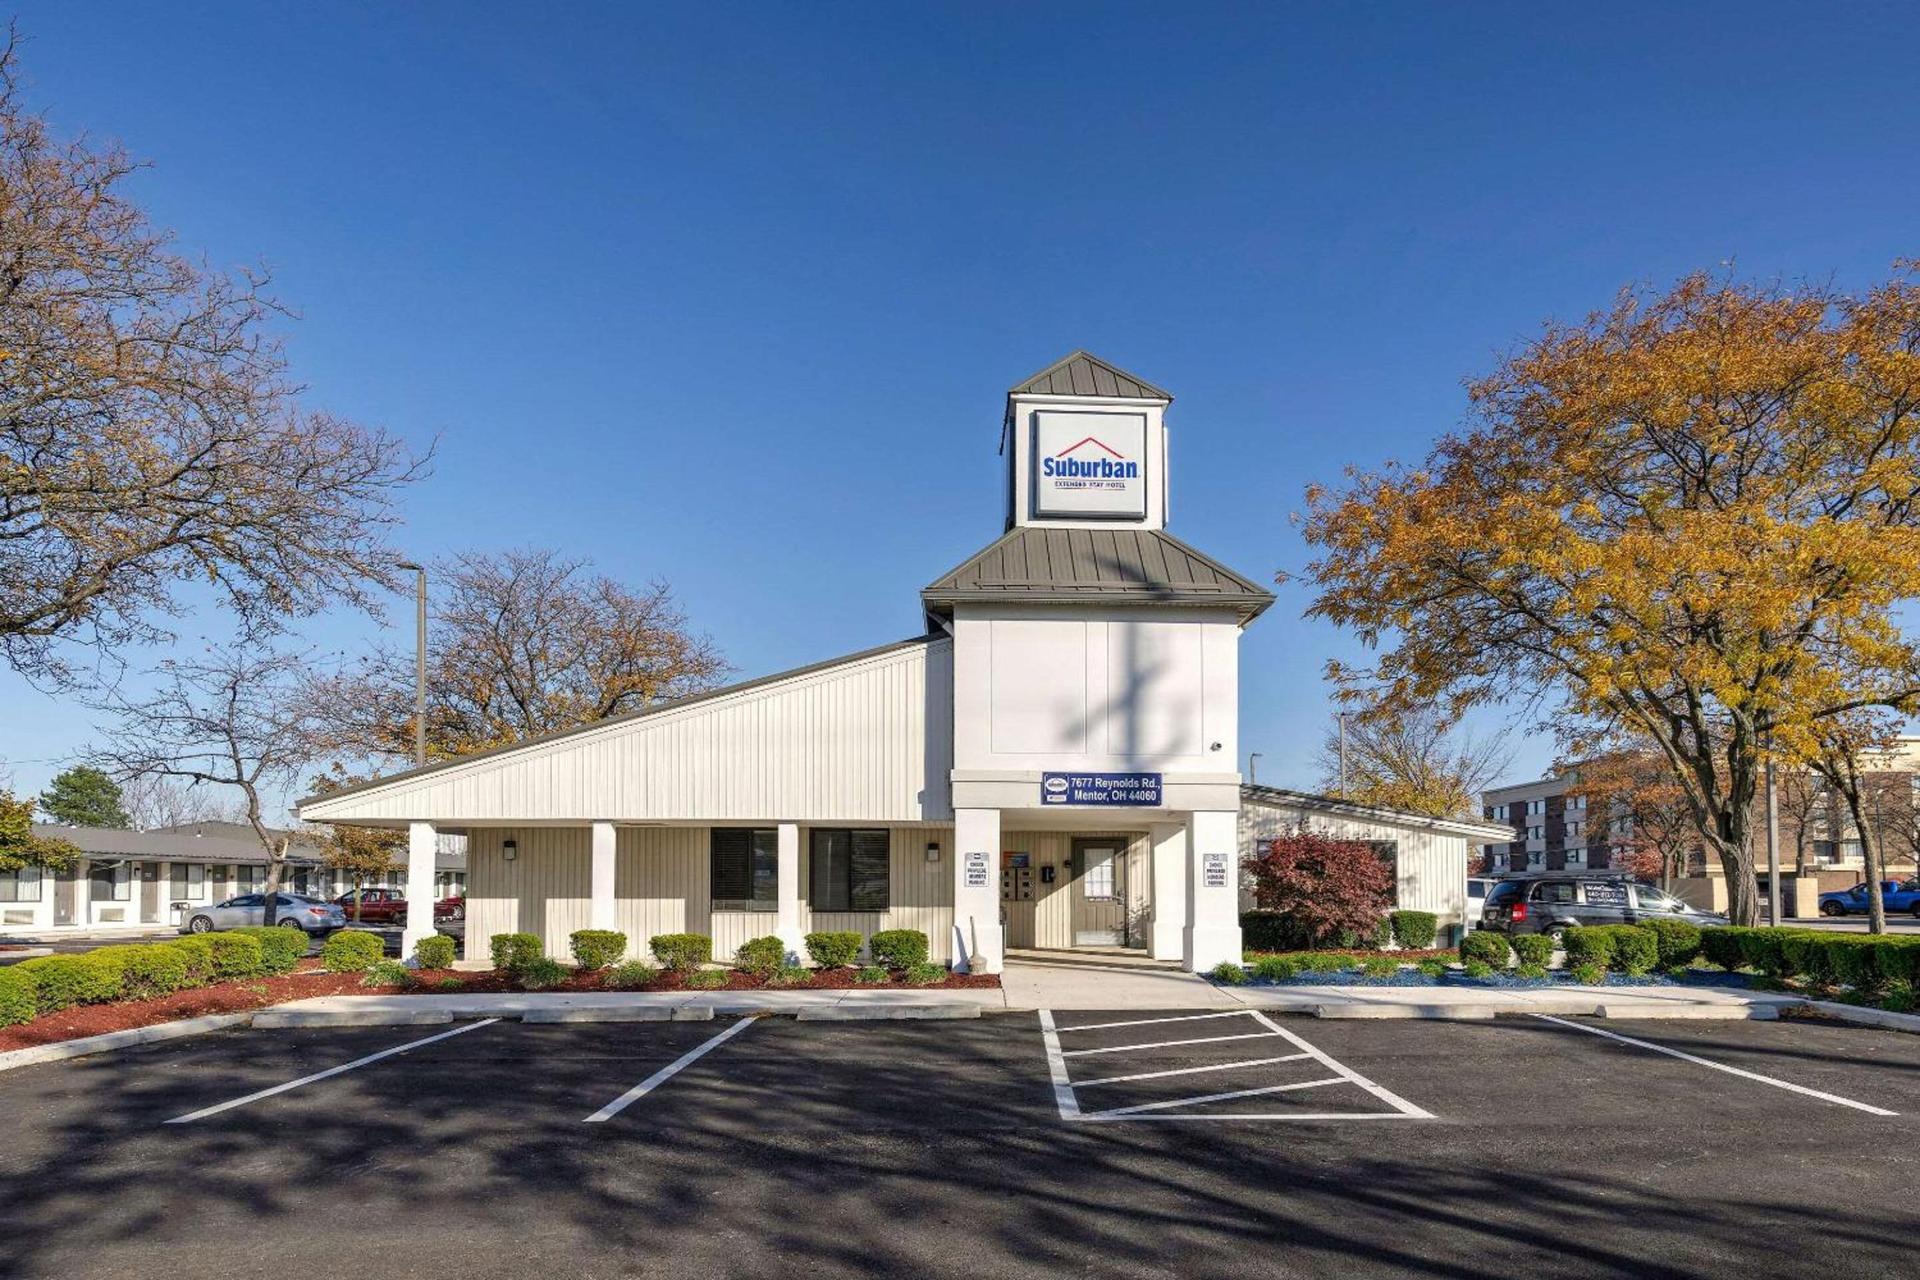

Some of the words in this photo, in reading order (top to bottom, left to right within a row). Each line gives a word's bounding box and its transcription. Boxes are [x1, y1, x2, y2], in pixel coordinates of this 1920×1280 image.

[1043, 457, 1138, 478] Suburban
[1071, 777, 1093, 788] 7677
[1095, 778, 1139, 790] Reynolds
[1074, 790, 1109, 802] Mentor,
[1111, 790, 1126, 801] OH
[1128, 790, 1157, 801] 44060
